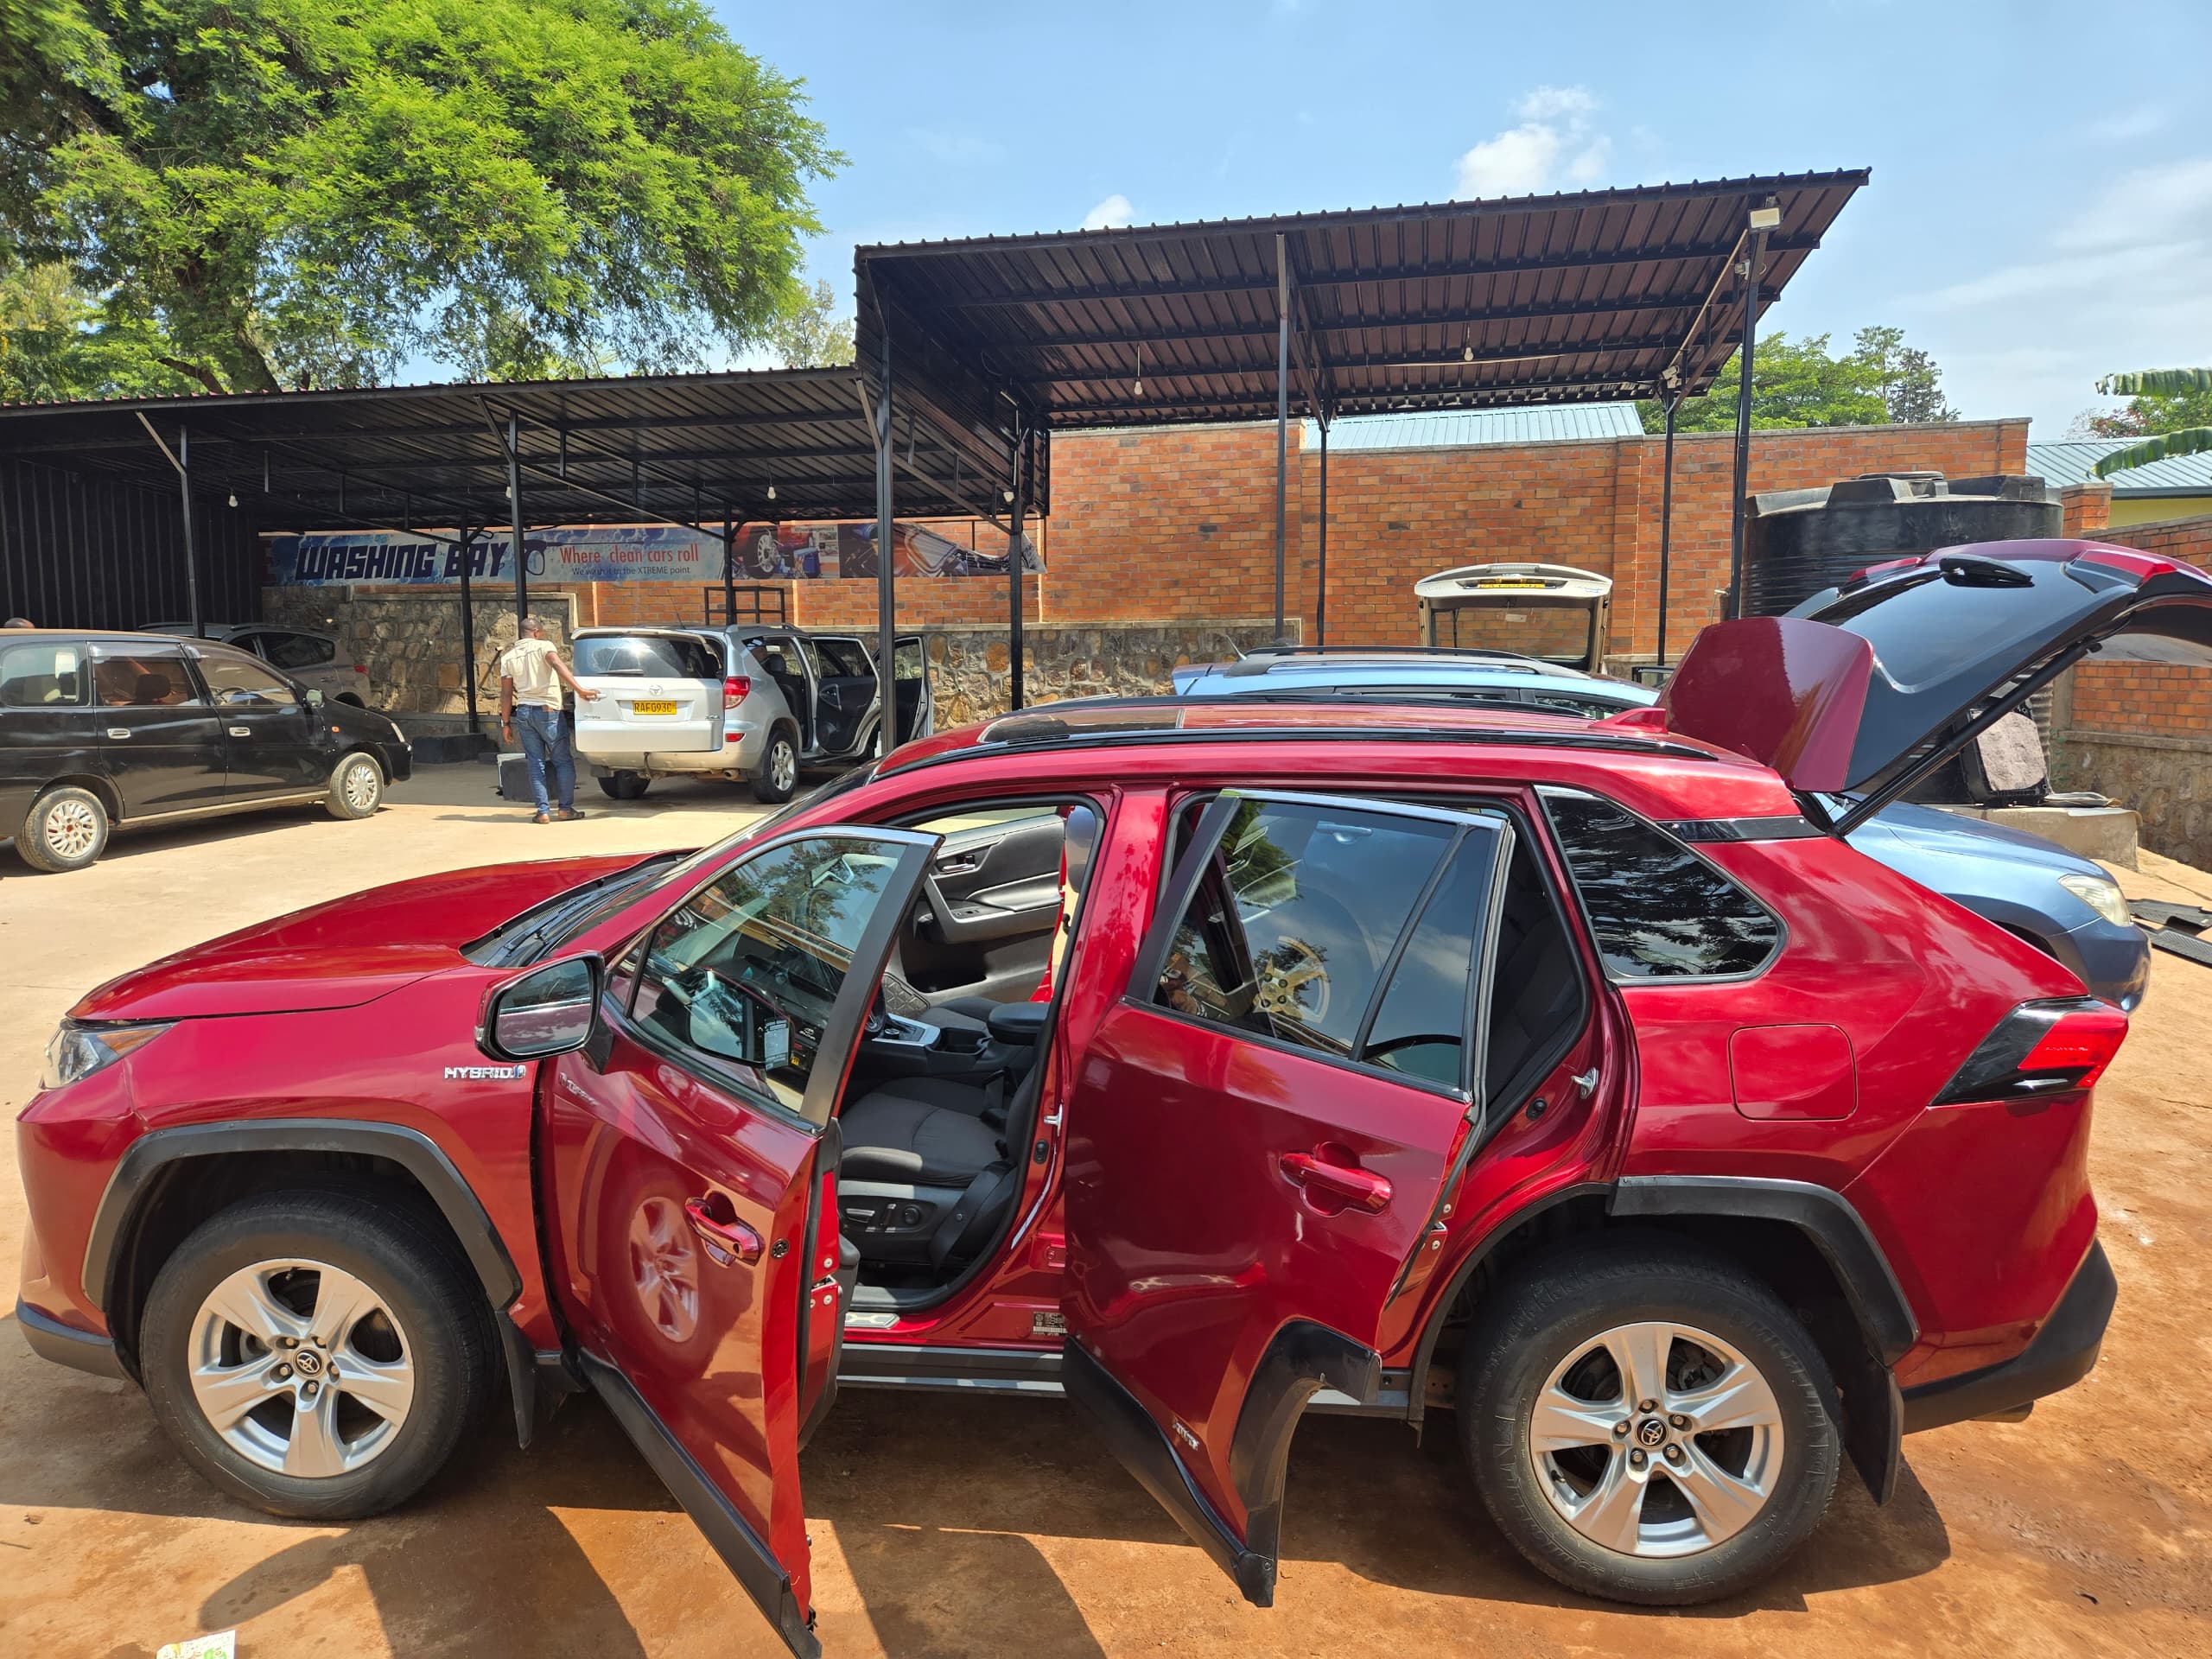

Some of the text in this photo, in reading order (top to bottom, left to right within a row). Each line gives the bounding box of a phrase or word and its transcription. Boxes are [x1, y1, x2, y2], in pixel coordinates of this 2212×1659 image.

[560, 543, 699, 563] Where clean cars roll
[295, 544, 436, 581] WASHING
[443, 542, 510, 578] BAY
[572, 567, 583, 575] We
[623, 566, 636, 575] the
[638, 566, 668, 575] XTREME
[670, 566, 690, 575] point
[444, 1066, 512, 1079] HYBRID
